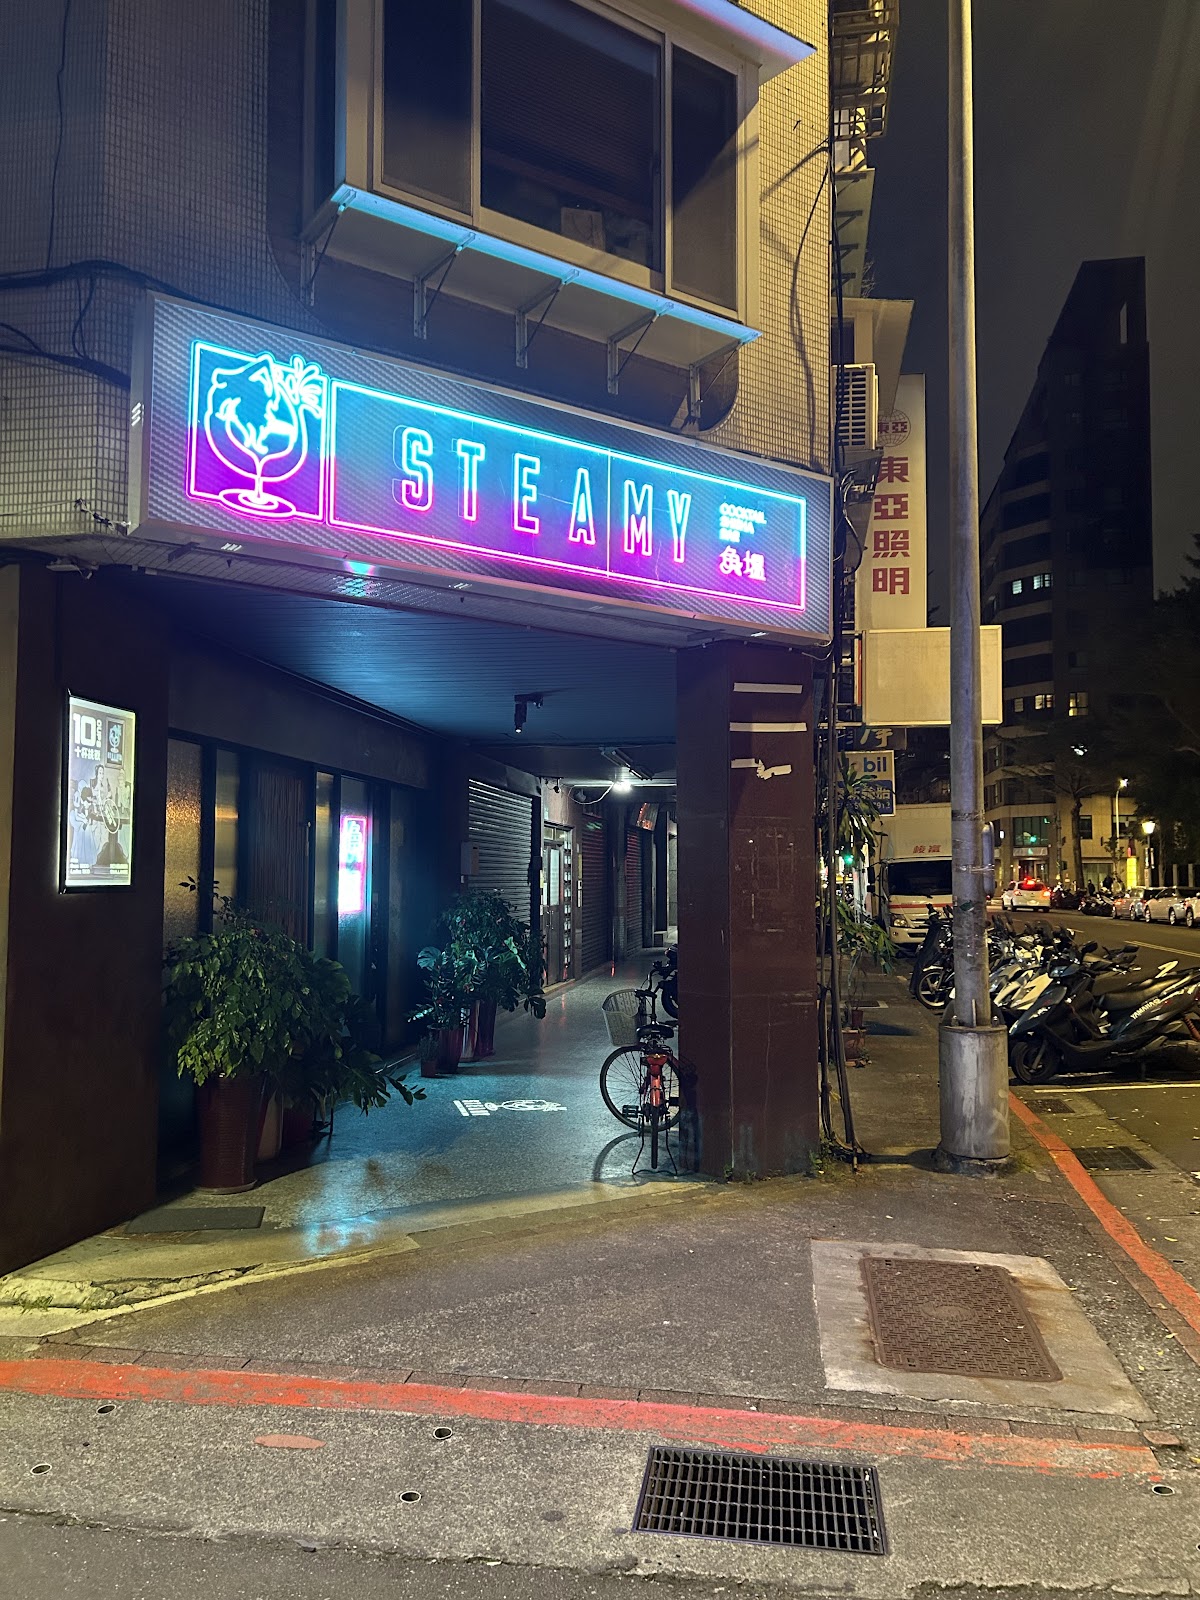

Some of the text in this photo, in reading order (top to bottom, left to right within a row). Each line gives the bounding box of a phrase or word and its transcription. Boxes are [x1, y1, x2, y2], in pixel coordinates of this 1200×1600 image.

[396, 426, 692, 564] STEAMY
[872, 456, 910, 595] 東亞照明
[72, 712, 97, 747] 10
